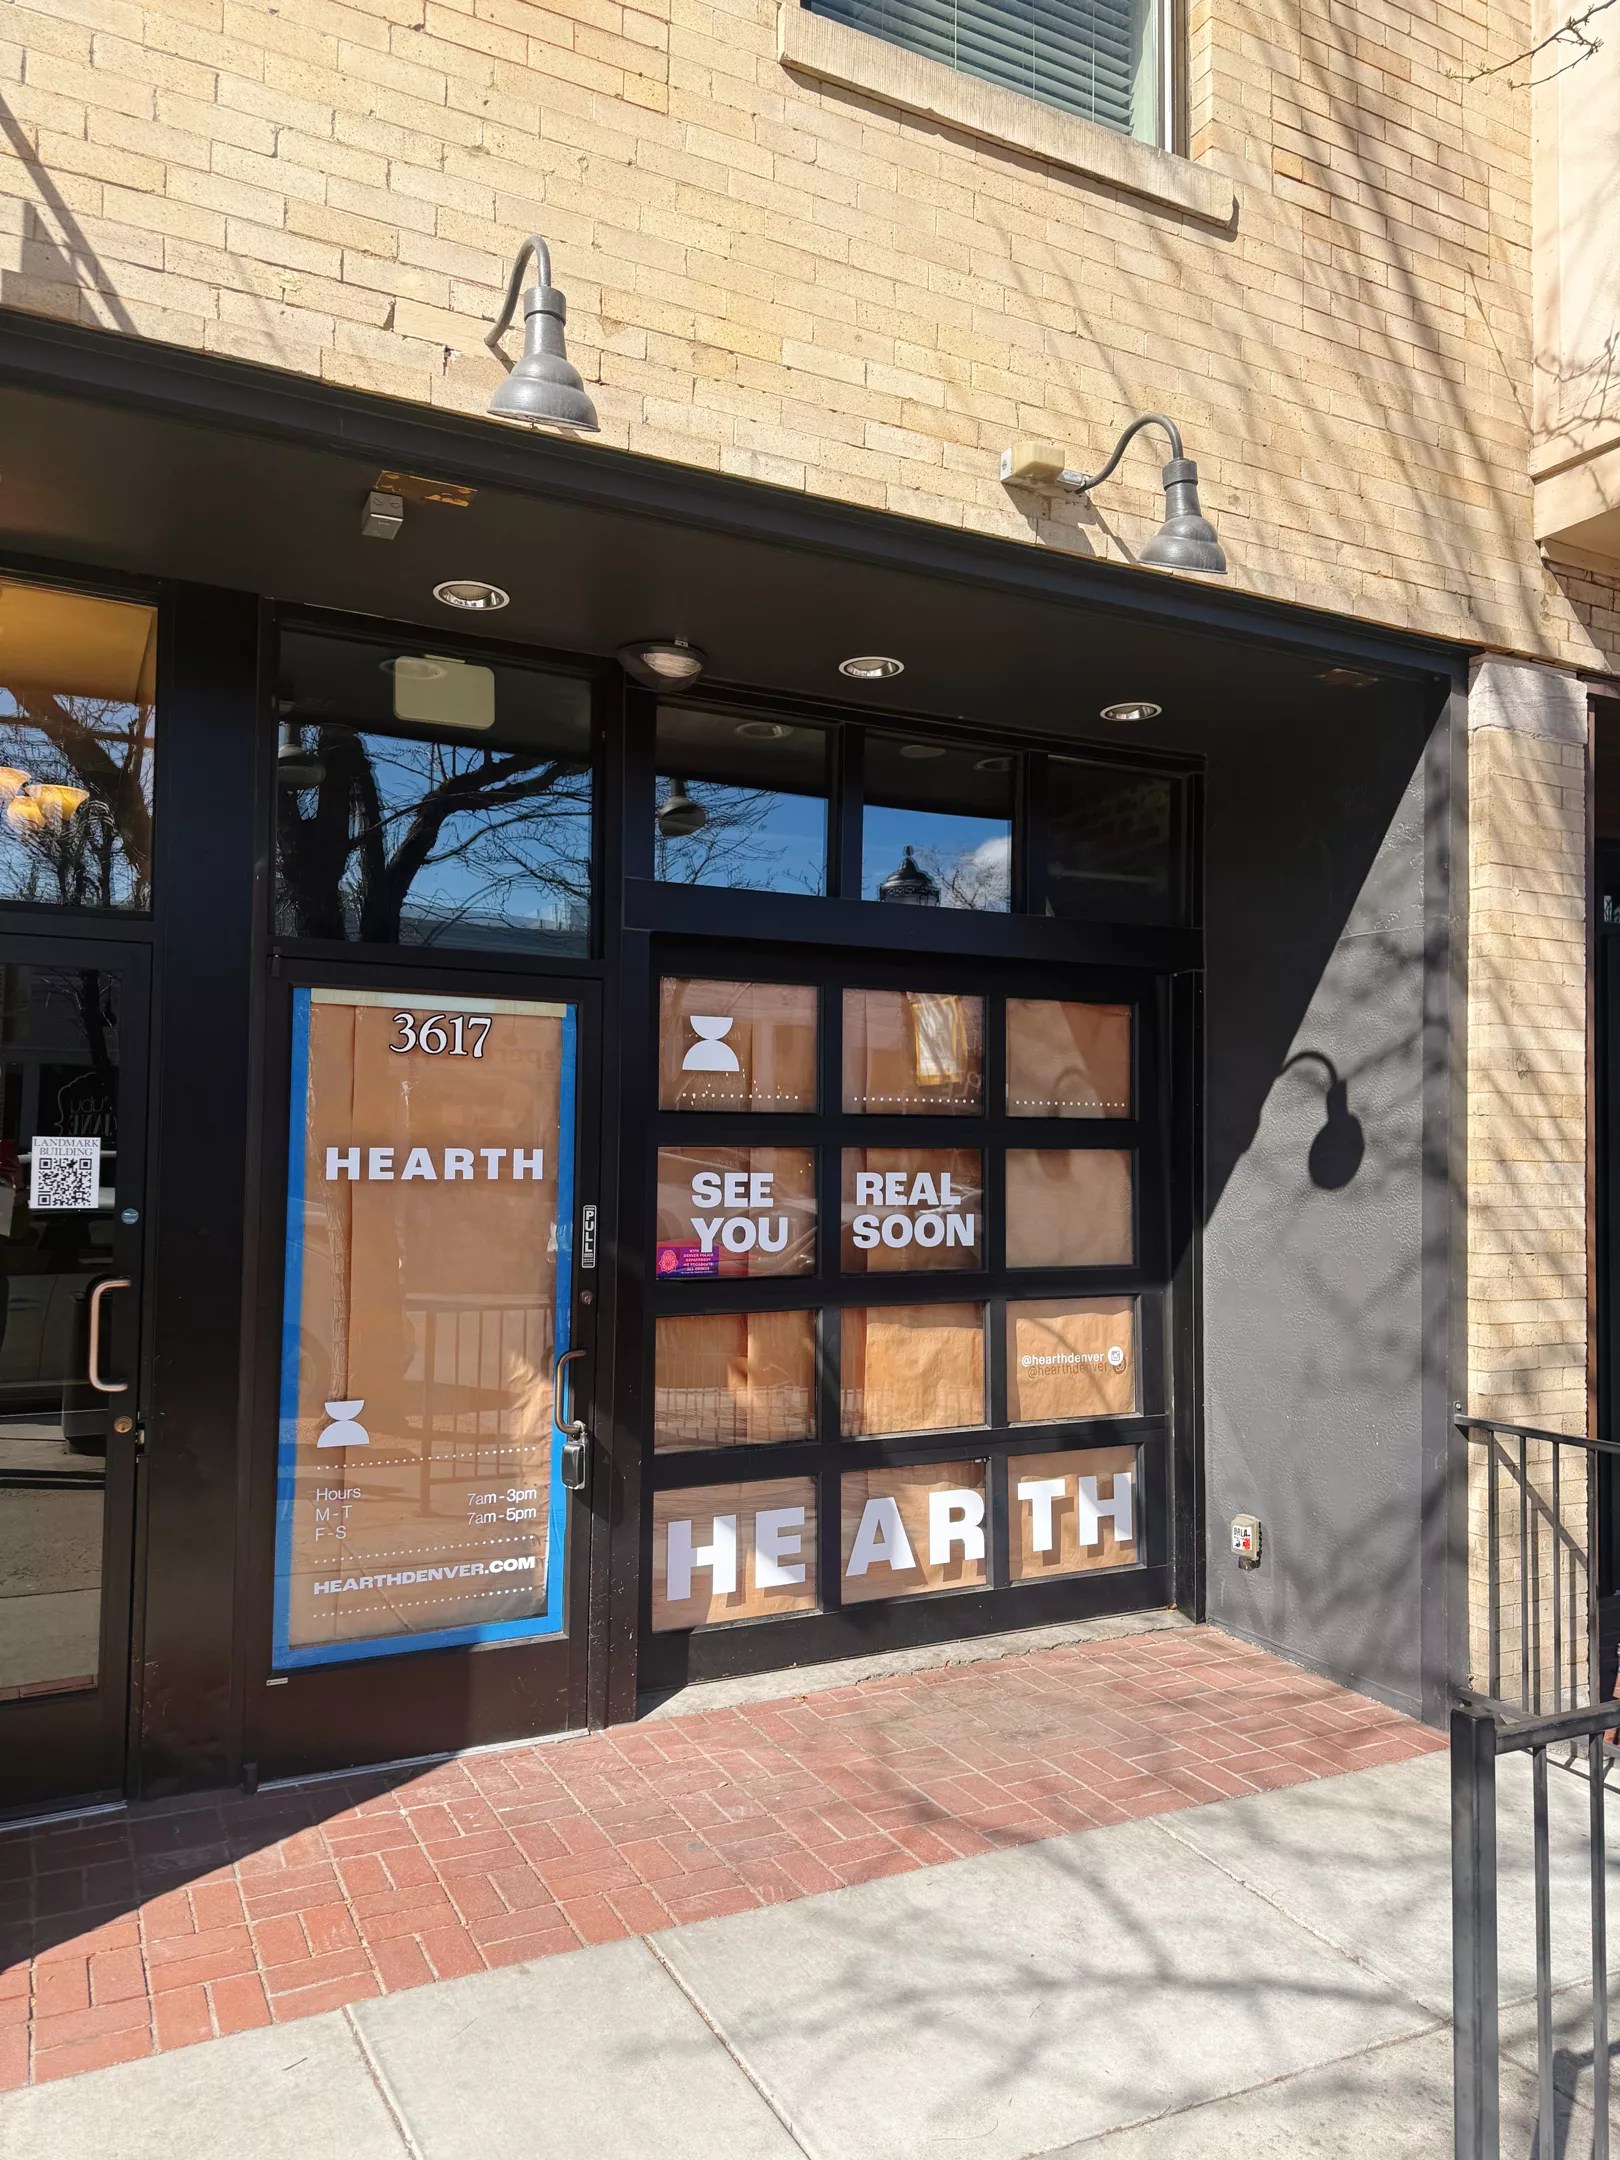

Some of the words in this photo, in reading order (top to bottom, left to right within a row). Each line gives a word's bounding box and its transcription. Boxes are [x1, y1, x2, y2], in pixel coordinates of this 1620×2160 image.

[389, 1012, 492, 1058] 3617
[33, 1138, 100, 1148] LANDMARK
[39, 1147, 93, 1156] BUILDING
[325, 1147, 544, 1181] HEARTH
[691, 1172, 774, 1208] SEE
[856, 1172, 961, 1206] REAL
[585, 1210, 595, 1253] PULL
[690, 1217, 789, 1253] YOU
[852, 1213, 975, 1249] SOON
[1021, 1353, 1104, 1367] @hearthdenver
[316, 1487, 361, 1502] Hours
[313, 1556, 536, 1595] HEARTHDENVER.COM
